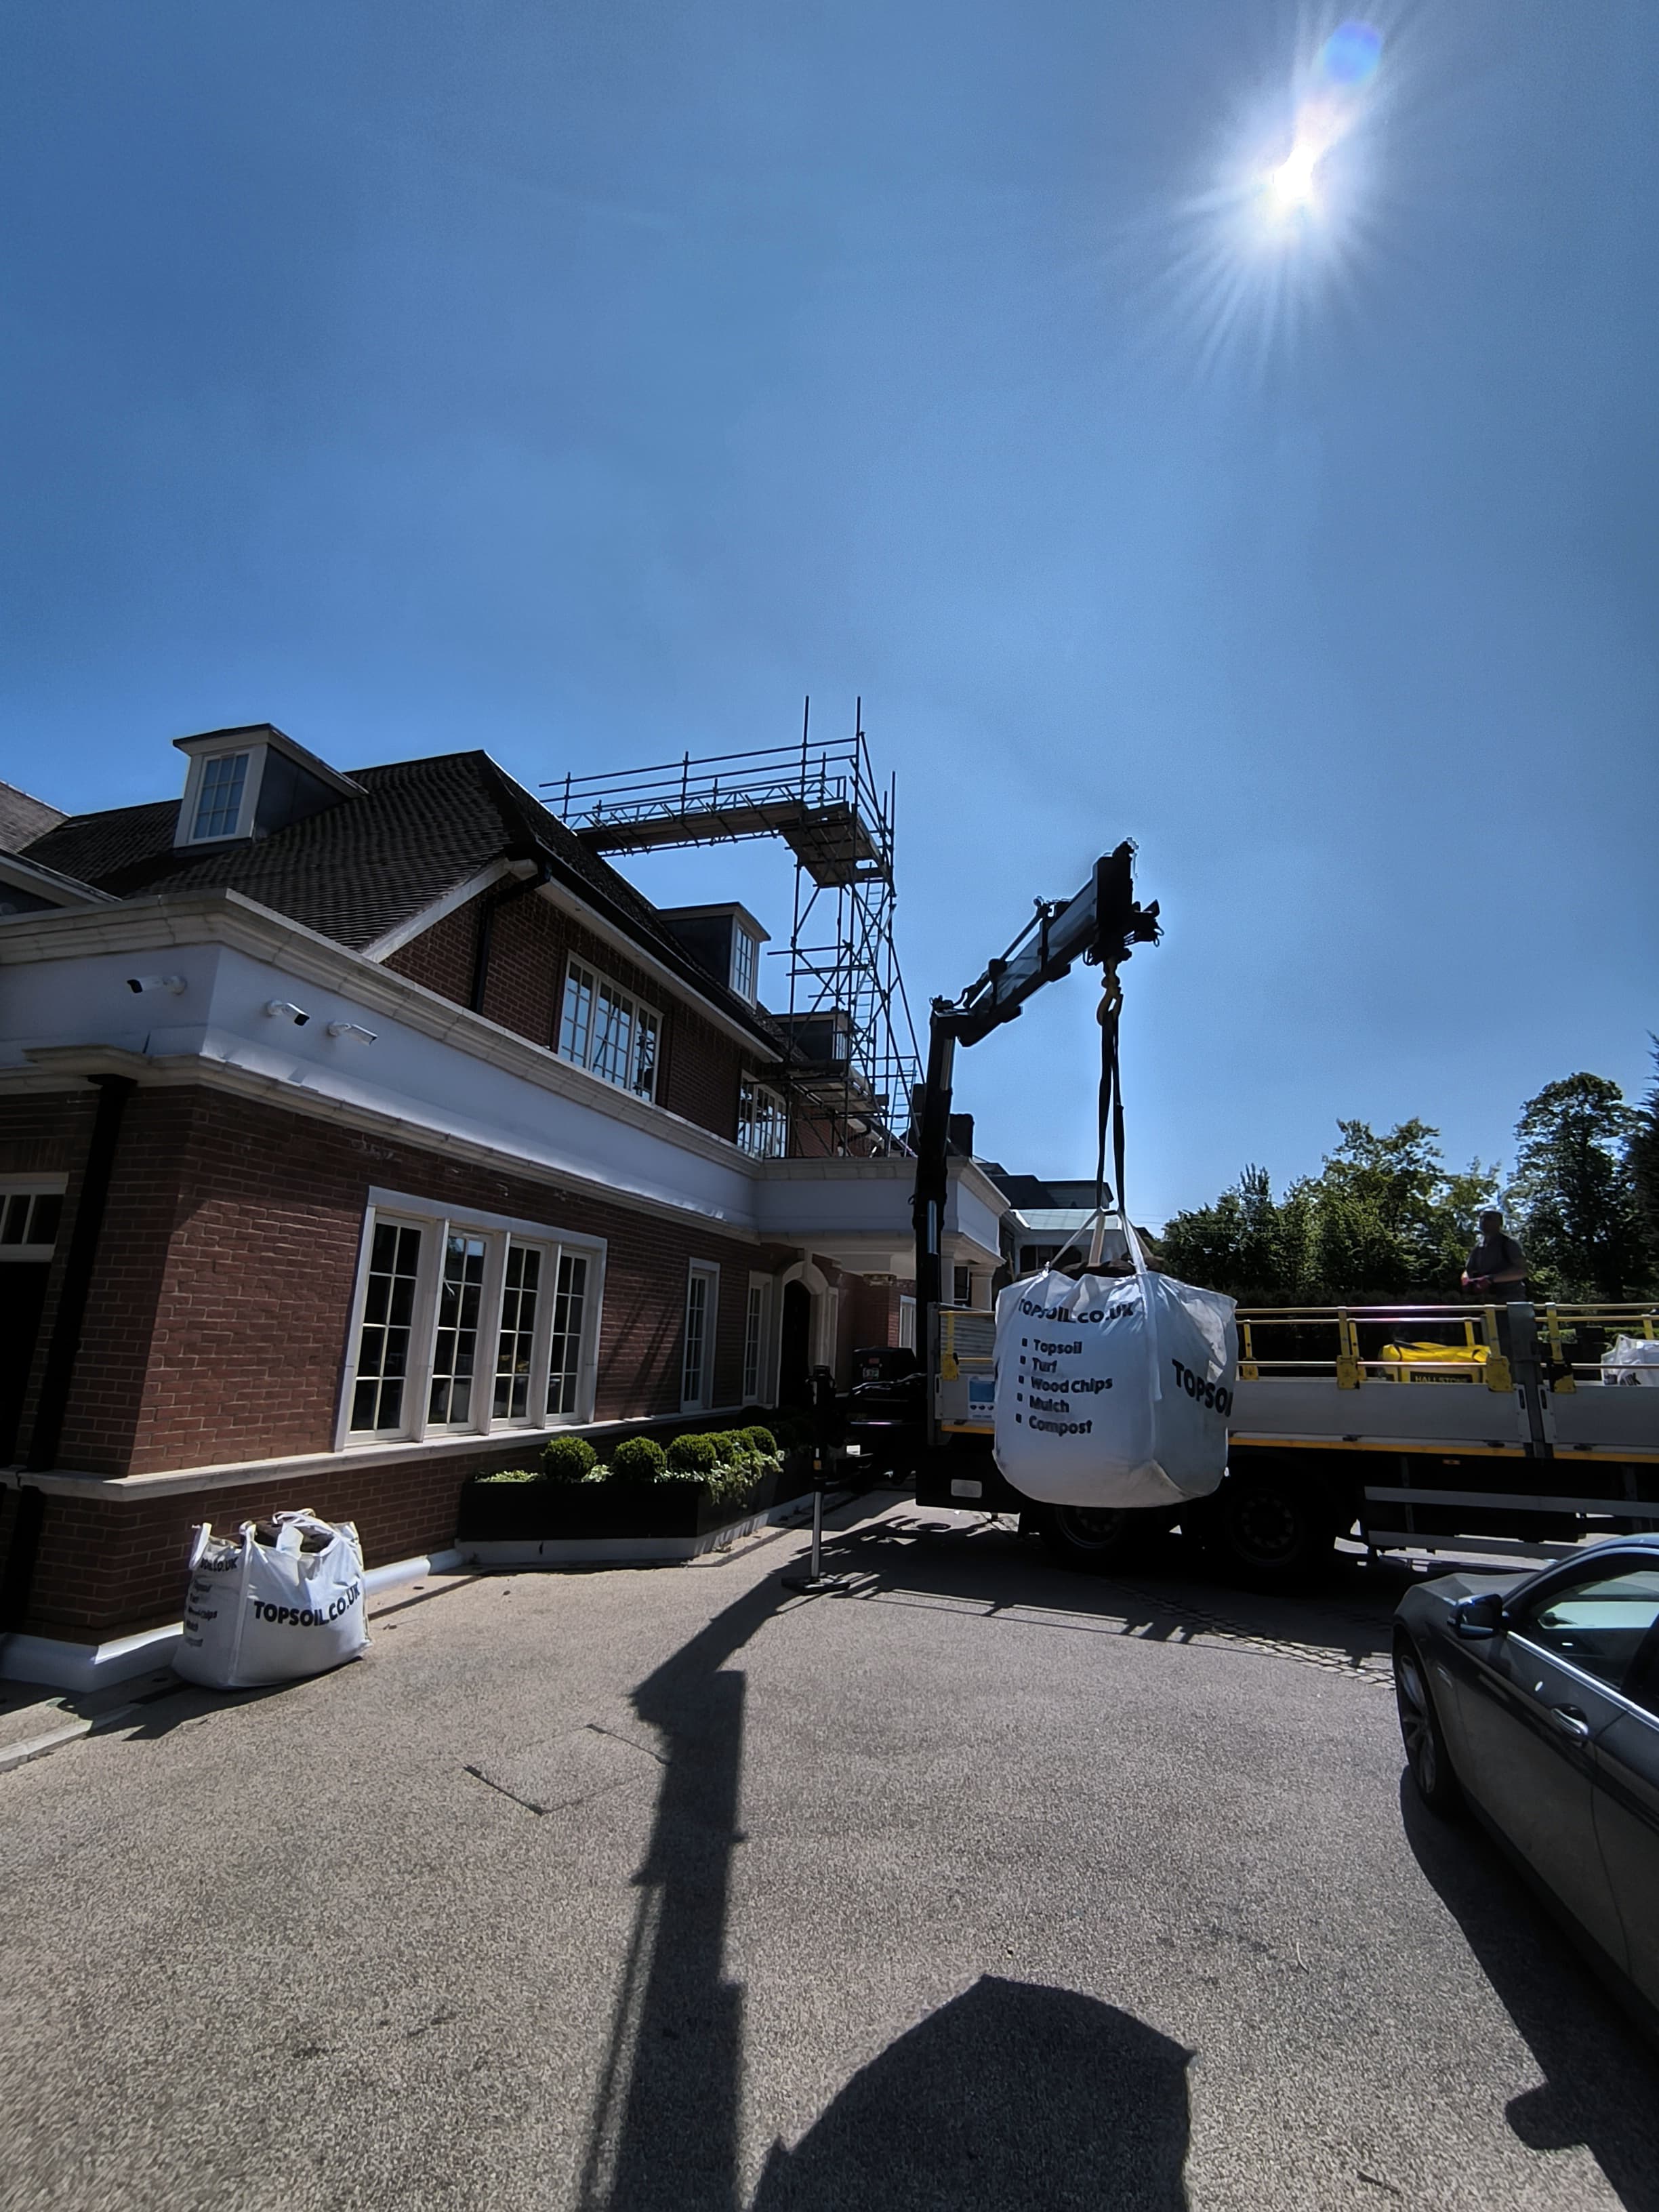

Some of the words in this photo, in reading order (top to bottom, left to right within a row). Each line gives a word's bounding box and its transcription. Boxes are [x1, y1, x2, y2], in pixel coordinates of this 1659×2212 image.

[1033, 1338, 1083, 1355] Topsoil
[1032, 1357, 1058, 1373] Turf
[1031, 1376, 1069, 1393] Wood
[1071, 1378, 1113, 1395] Chips
[1029, 1395, 1070, 1413] Mulch
[1029, 1415, 1093, 1437] Compost
[254, 1582, 361, 1626] TOPSOIL.CO.UK
